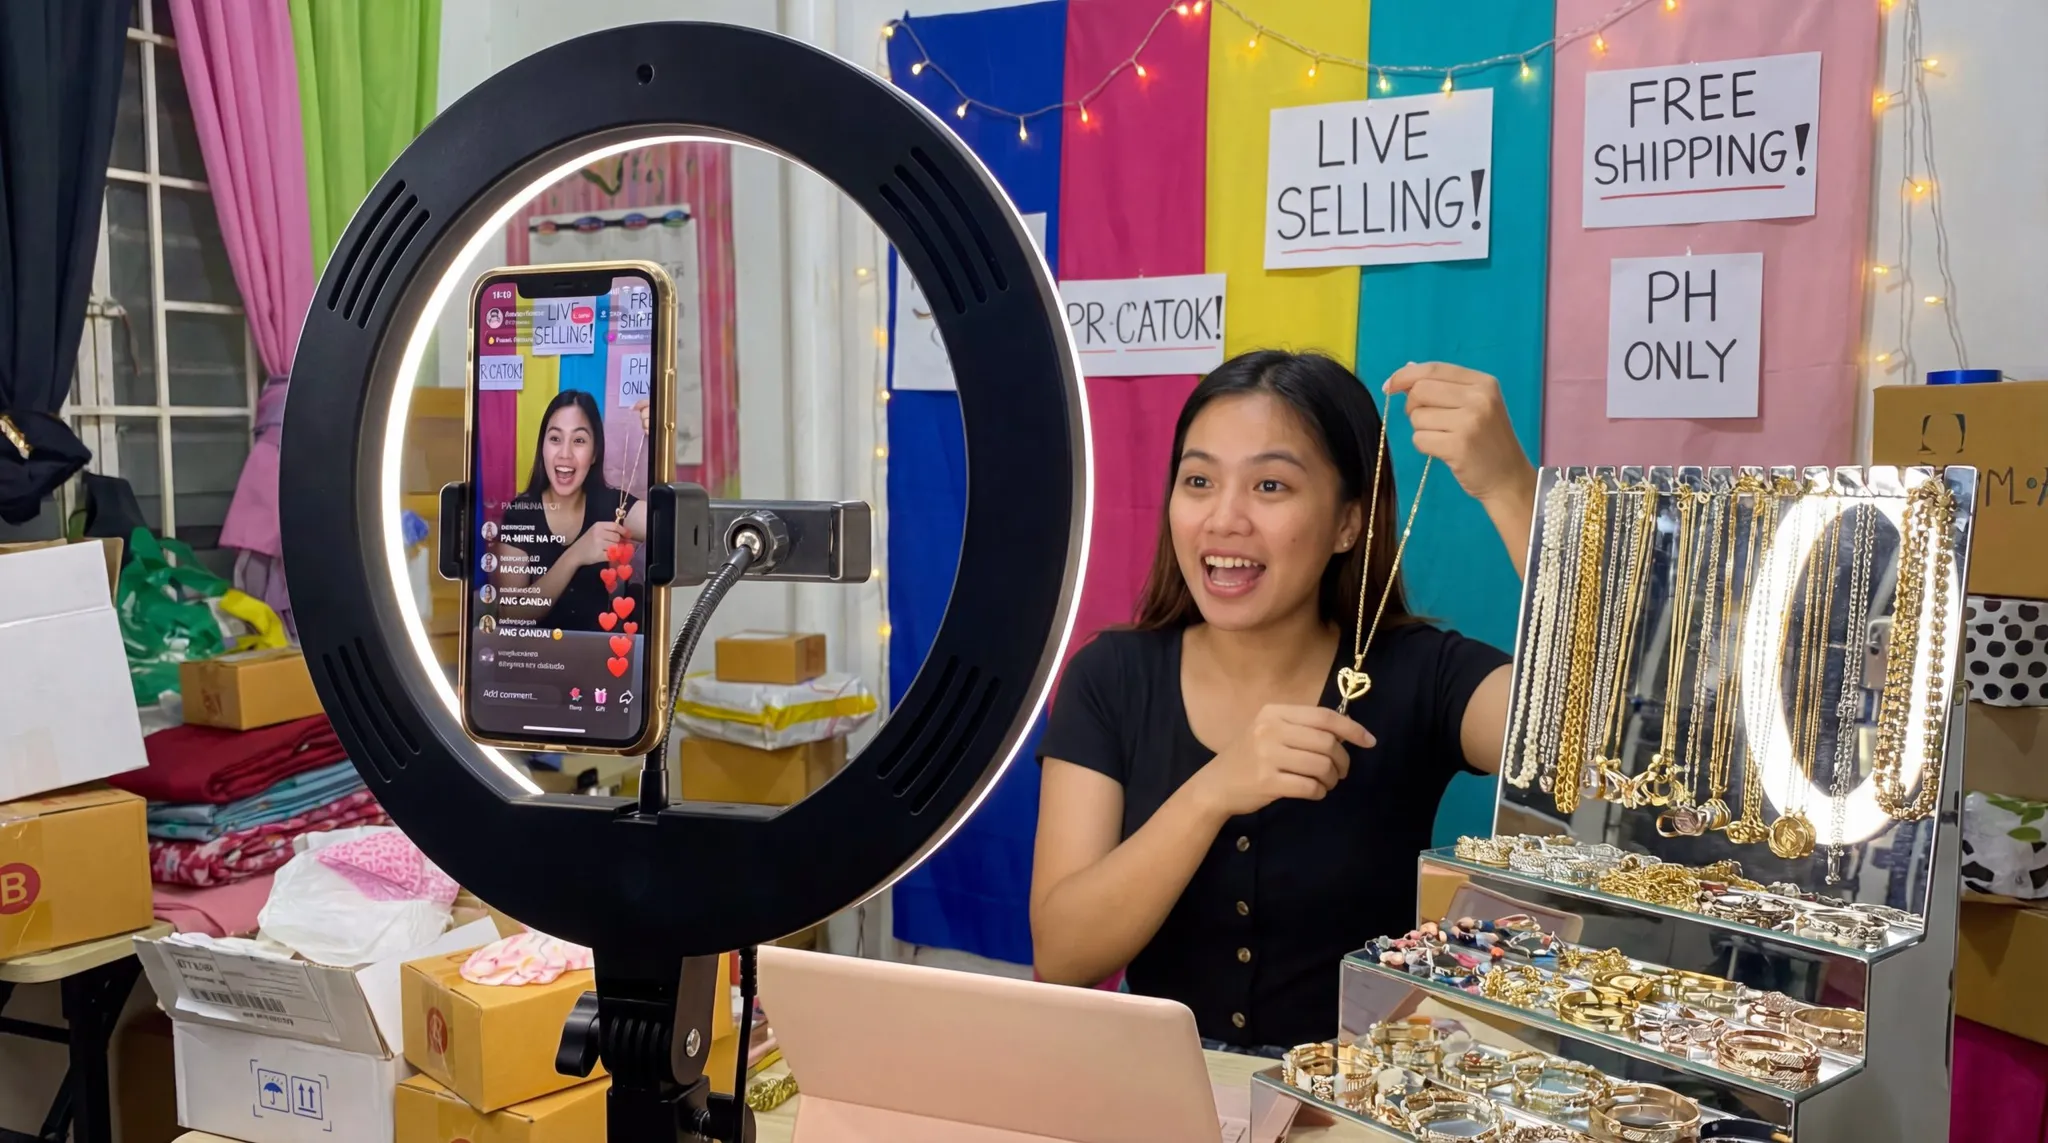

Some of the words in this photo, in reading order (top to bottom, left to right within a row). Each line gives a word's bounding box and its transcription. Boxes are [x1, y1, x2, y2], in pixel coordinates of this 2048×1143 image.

[1629, 70, 1758, 128] FREE
[1318, 110, 1430, 168] LIVE
[1593, 123, 1811, 185] SHIPPING!
[1277, 169, 1486, 241] SELLING!
[1647, 269, 1717, 324] PH
[534, 323, 593, 346] SELLING!
[629, 357, 648, 375] PH
[1624, 338, 1738, 383] ONLY
[536, 535, 549, 543] NA
[500, 565, 547, 575] MAGKANO?
[500, 597, 518, 605] ANG
[519, 598, 552, 607] GANDA!
[499, 628, 517, 637] ANG
[518, 629, 551, 638] GANDA!
[483, 689, 499, 698] Add
[1, 872, 28, 907] B
